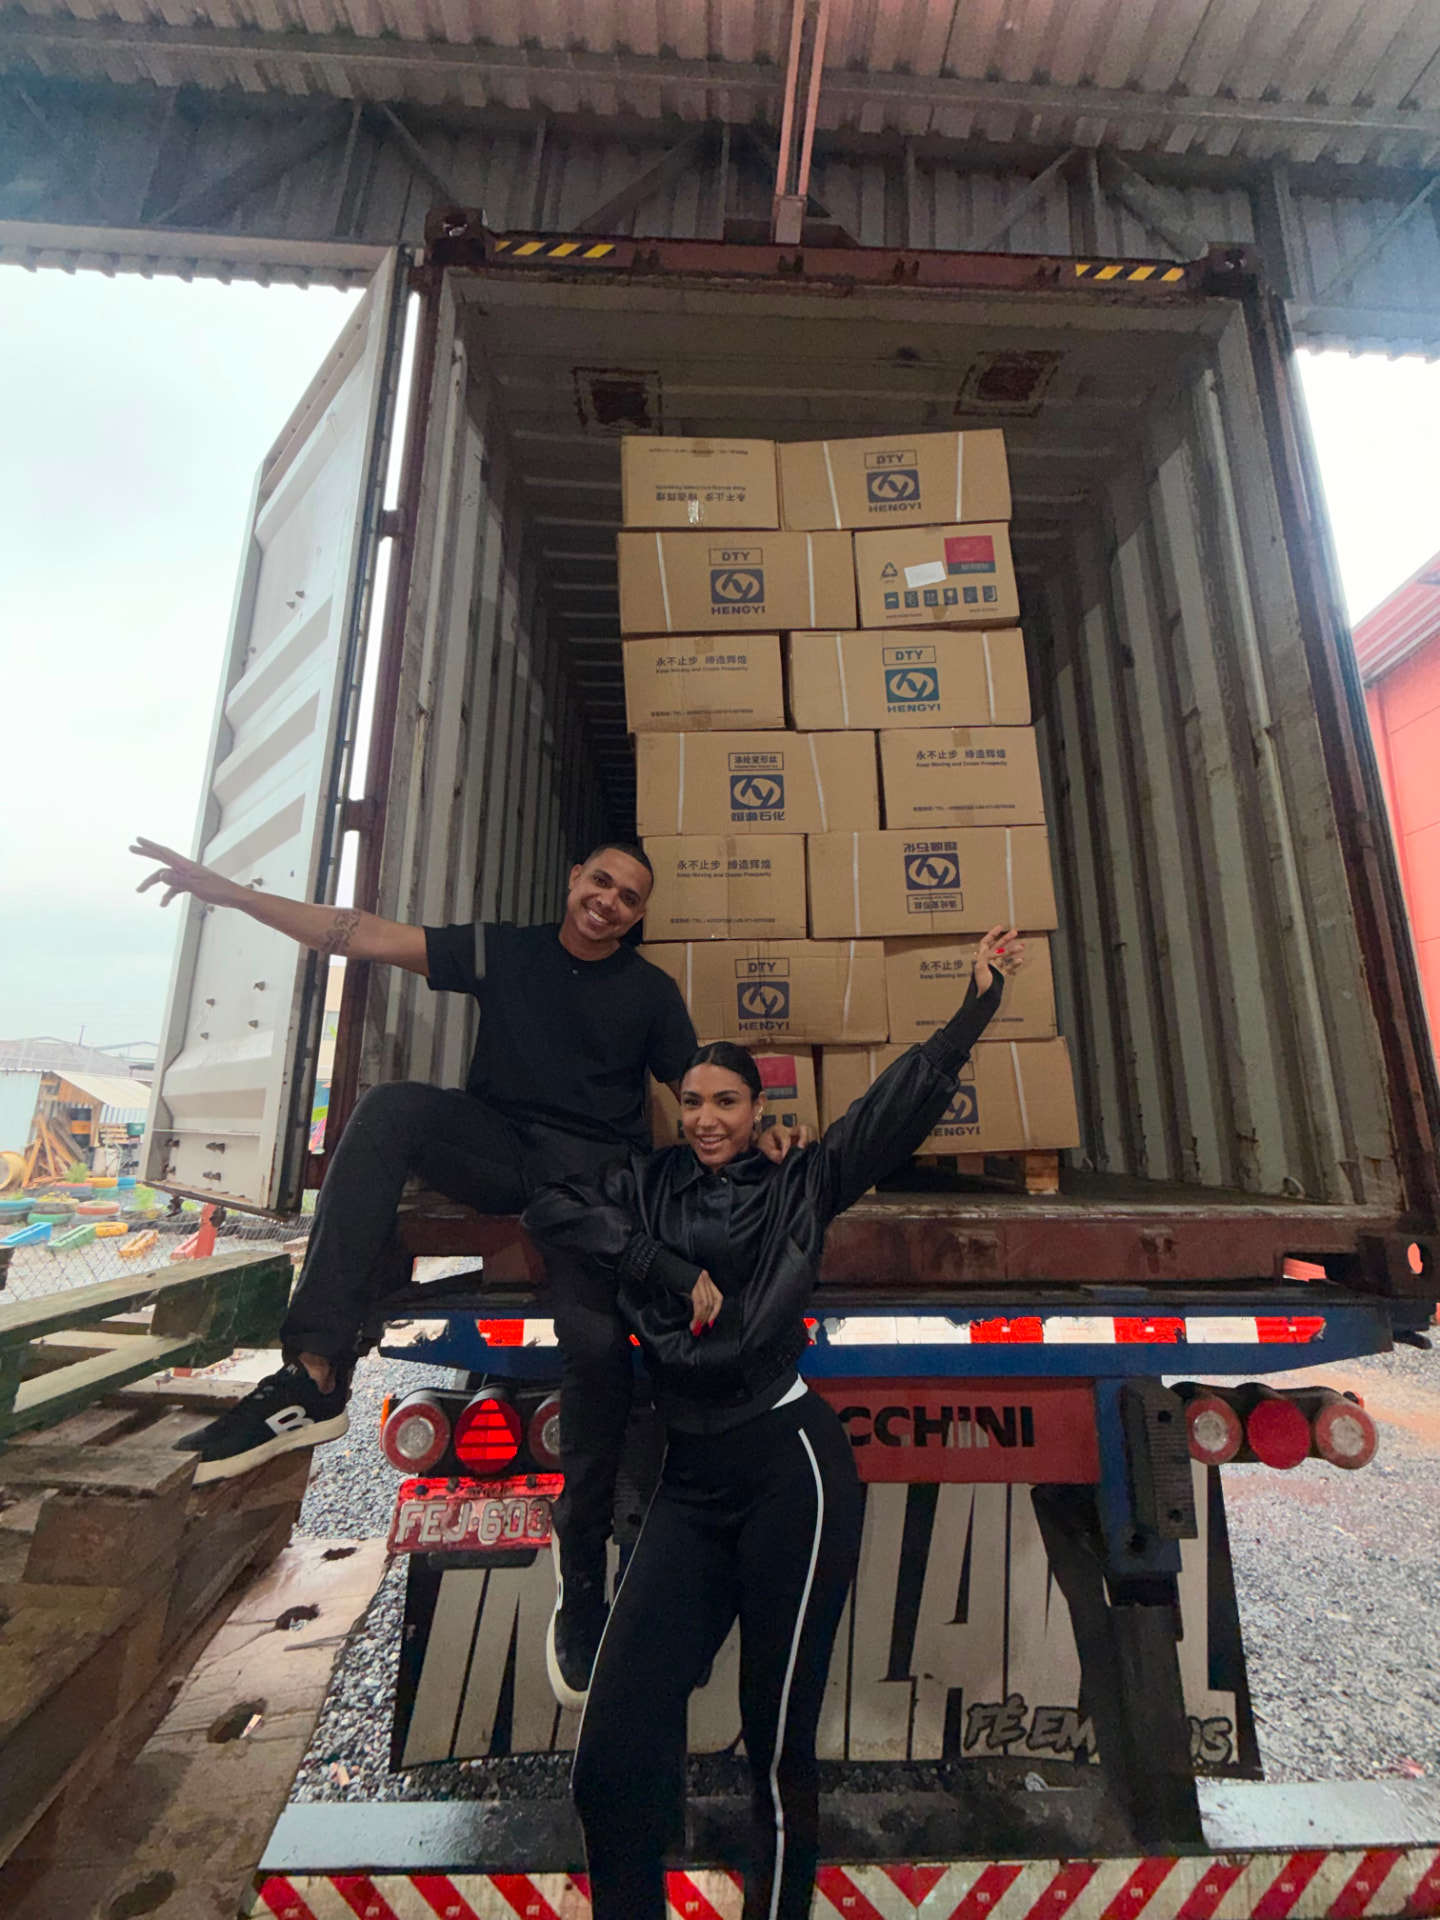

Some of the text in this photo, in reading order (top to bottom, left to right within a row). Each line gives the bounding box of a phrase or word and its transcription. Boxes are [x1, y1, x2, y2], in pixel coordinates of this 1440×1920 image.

[877, 454, 904, 464] DTY
[868, 502, 921, 512] HENGYI
[722, 551, 750, 561] DTY
[711, 605, 766, 615] HENGYI
[895, 650, 923, 661] DTY
[656, 656, 698, 667] 永不止步
[887, 703, 942, 713] HENGYI
[916, 750, 958, 760] 永不止步
[677, 859, 720, 870] 永不止步
[748, 962, 776, 973] DTY
[919, 959, 963, 971] 永不止步
[739, 1021, 790, 1031] HENGYI
[963, 1692, 1028, 1751] FÉ
